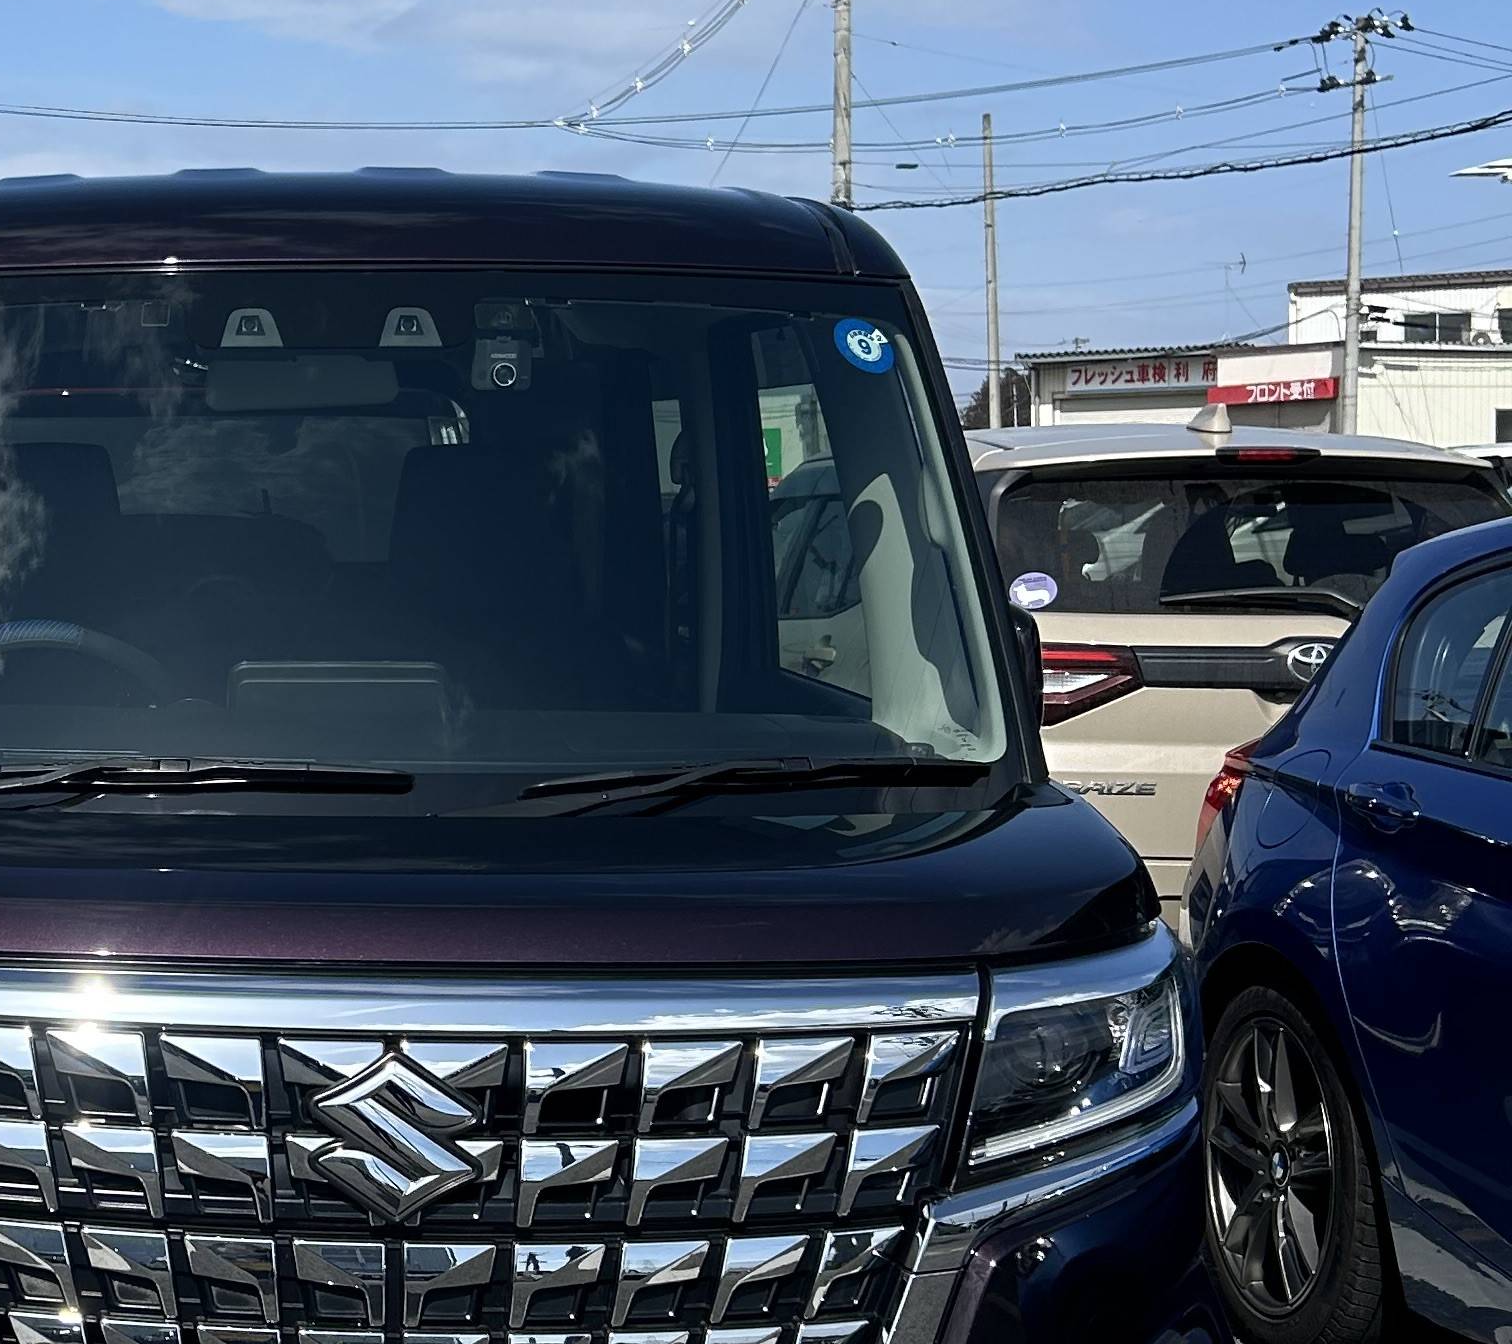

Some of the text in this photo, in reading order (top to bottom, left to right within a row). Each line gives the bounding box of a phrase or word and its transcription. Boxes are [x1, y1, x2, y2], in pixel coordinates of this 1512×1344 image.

[1071, 362, 1166, 386] フレッシュ車検
[1246, 381, 1315, 403] フロント受付
